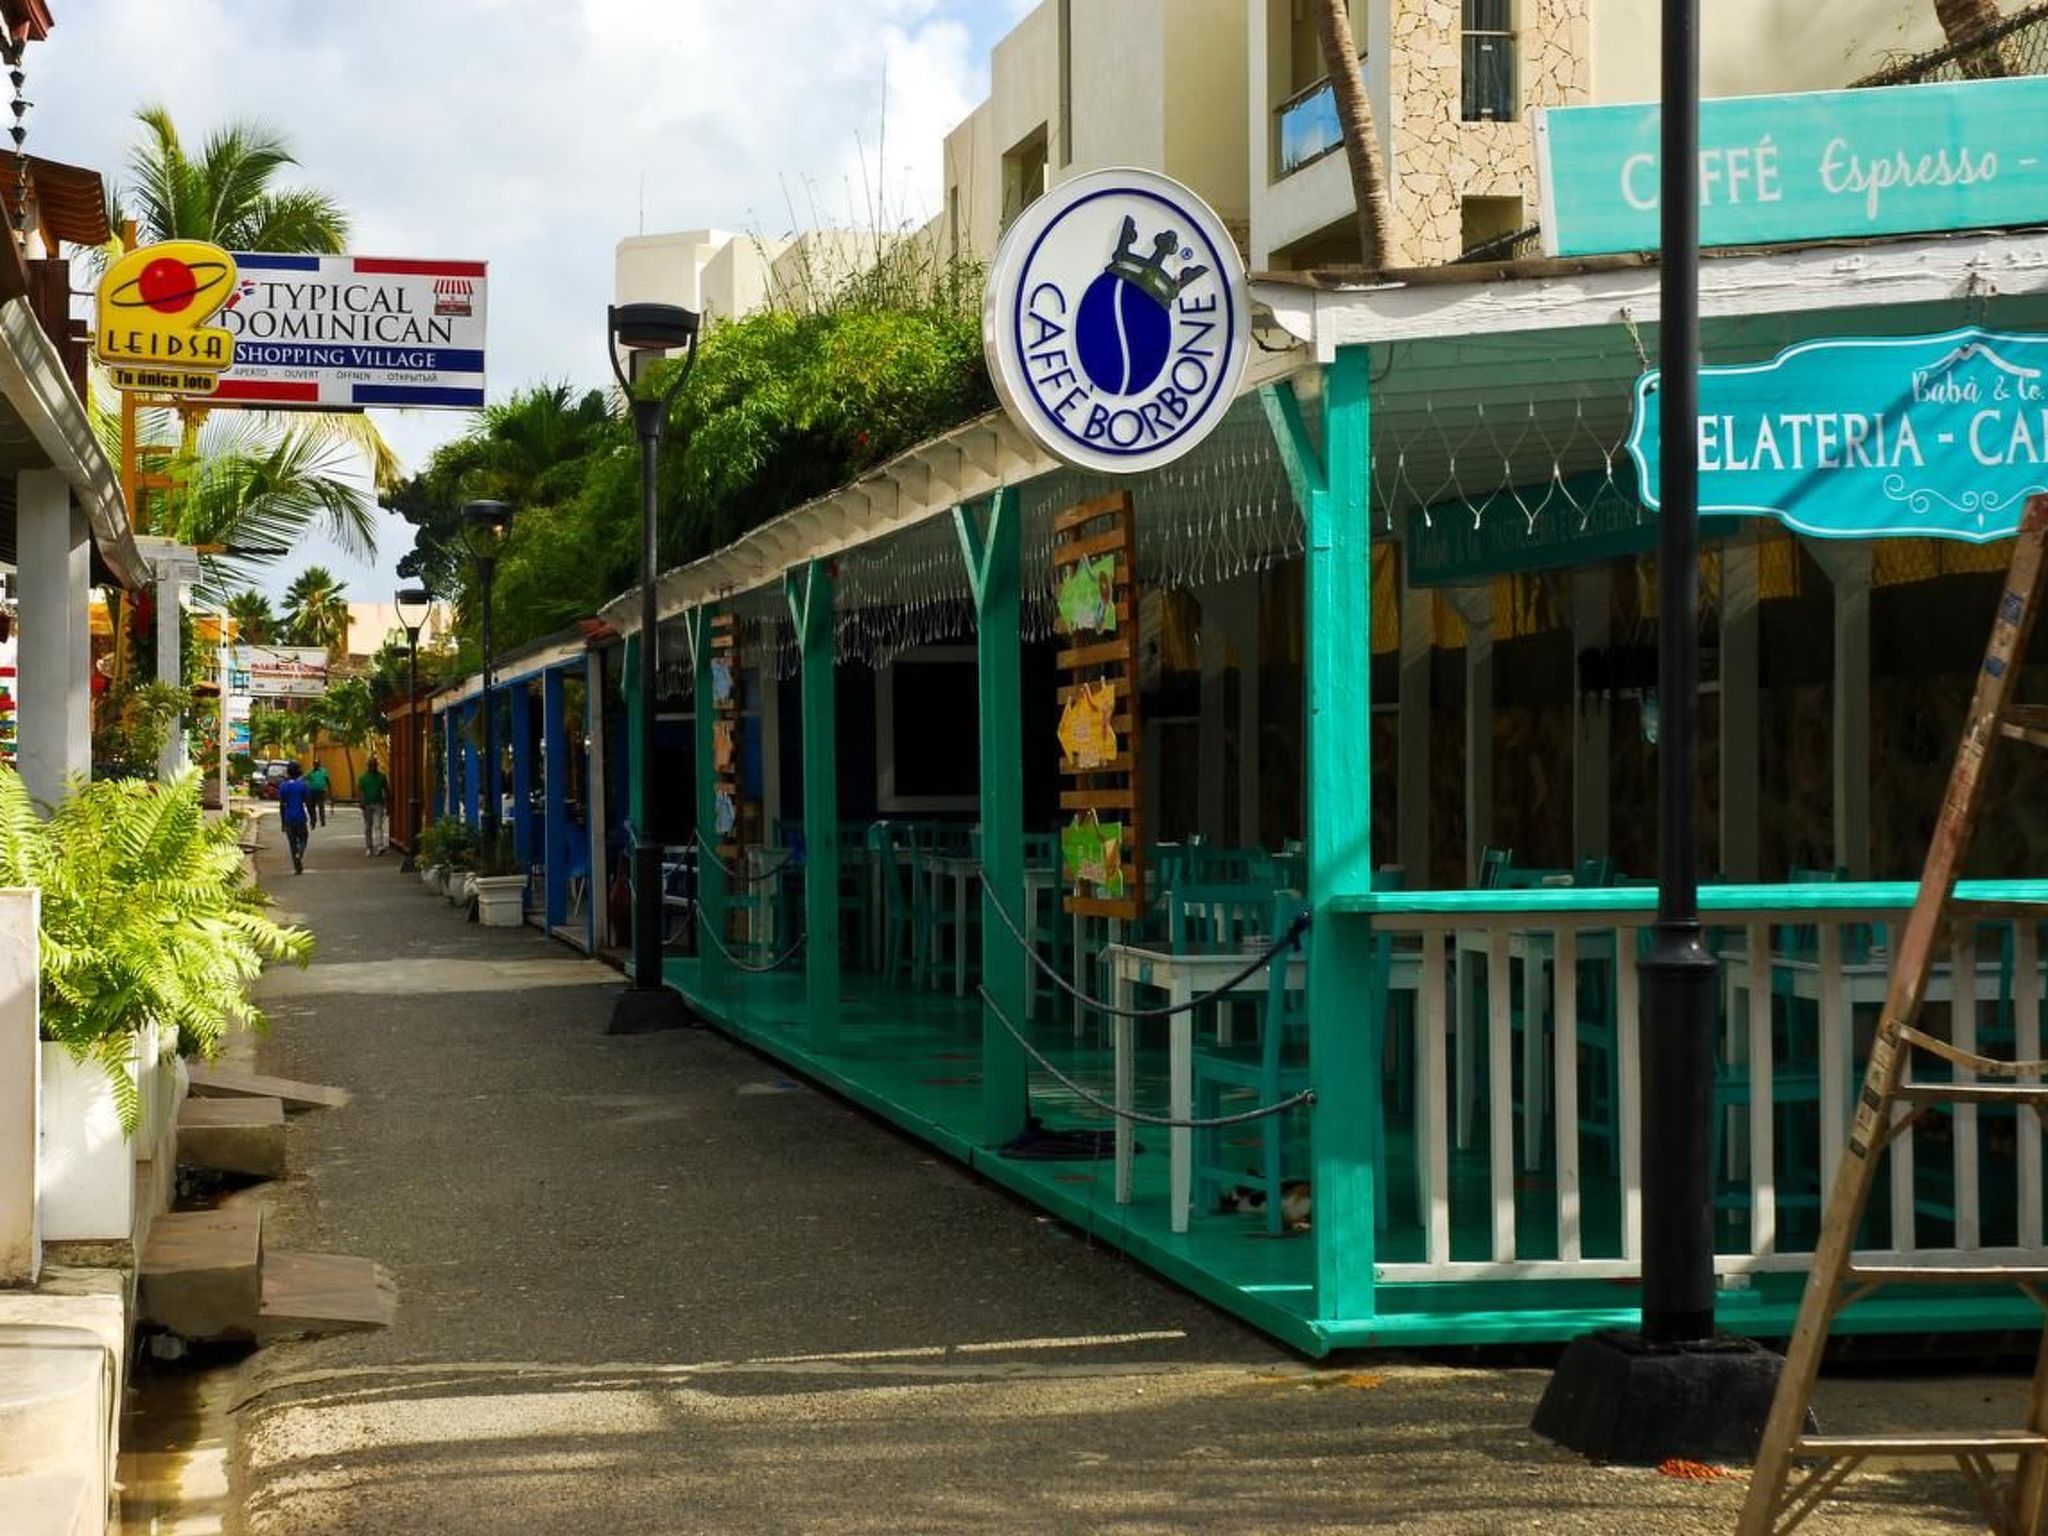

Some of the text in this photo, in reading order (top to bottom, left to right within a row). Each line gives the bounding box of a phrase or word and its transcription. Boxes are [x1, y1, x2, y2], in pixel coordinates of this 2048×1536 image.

[1620, 132, 1783, 211] CFFÉ
[1818, 136, 1998, 221] Espresso
[259, 281, 414, 315] TYPICAL
[219, 309, 453, 345] DOMINICAN
[107, 330, 223, 360] LEIDSA
[236, 342, 437, 369] SHOPPING VILLAGE
[116, 370, 213, 390] Tu única loto
[284, 369, 319, 379] OUVERT
[1083, 293, 1218, 448] BORBONE
[1993, 376, 2011, 401] &
[1658, 411, 1925, 470] ELATERIA
